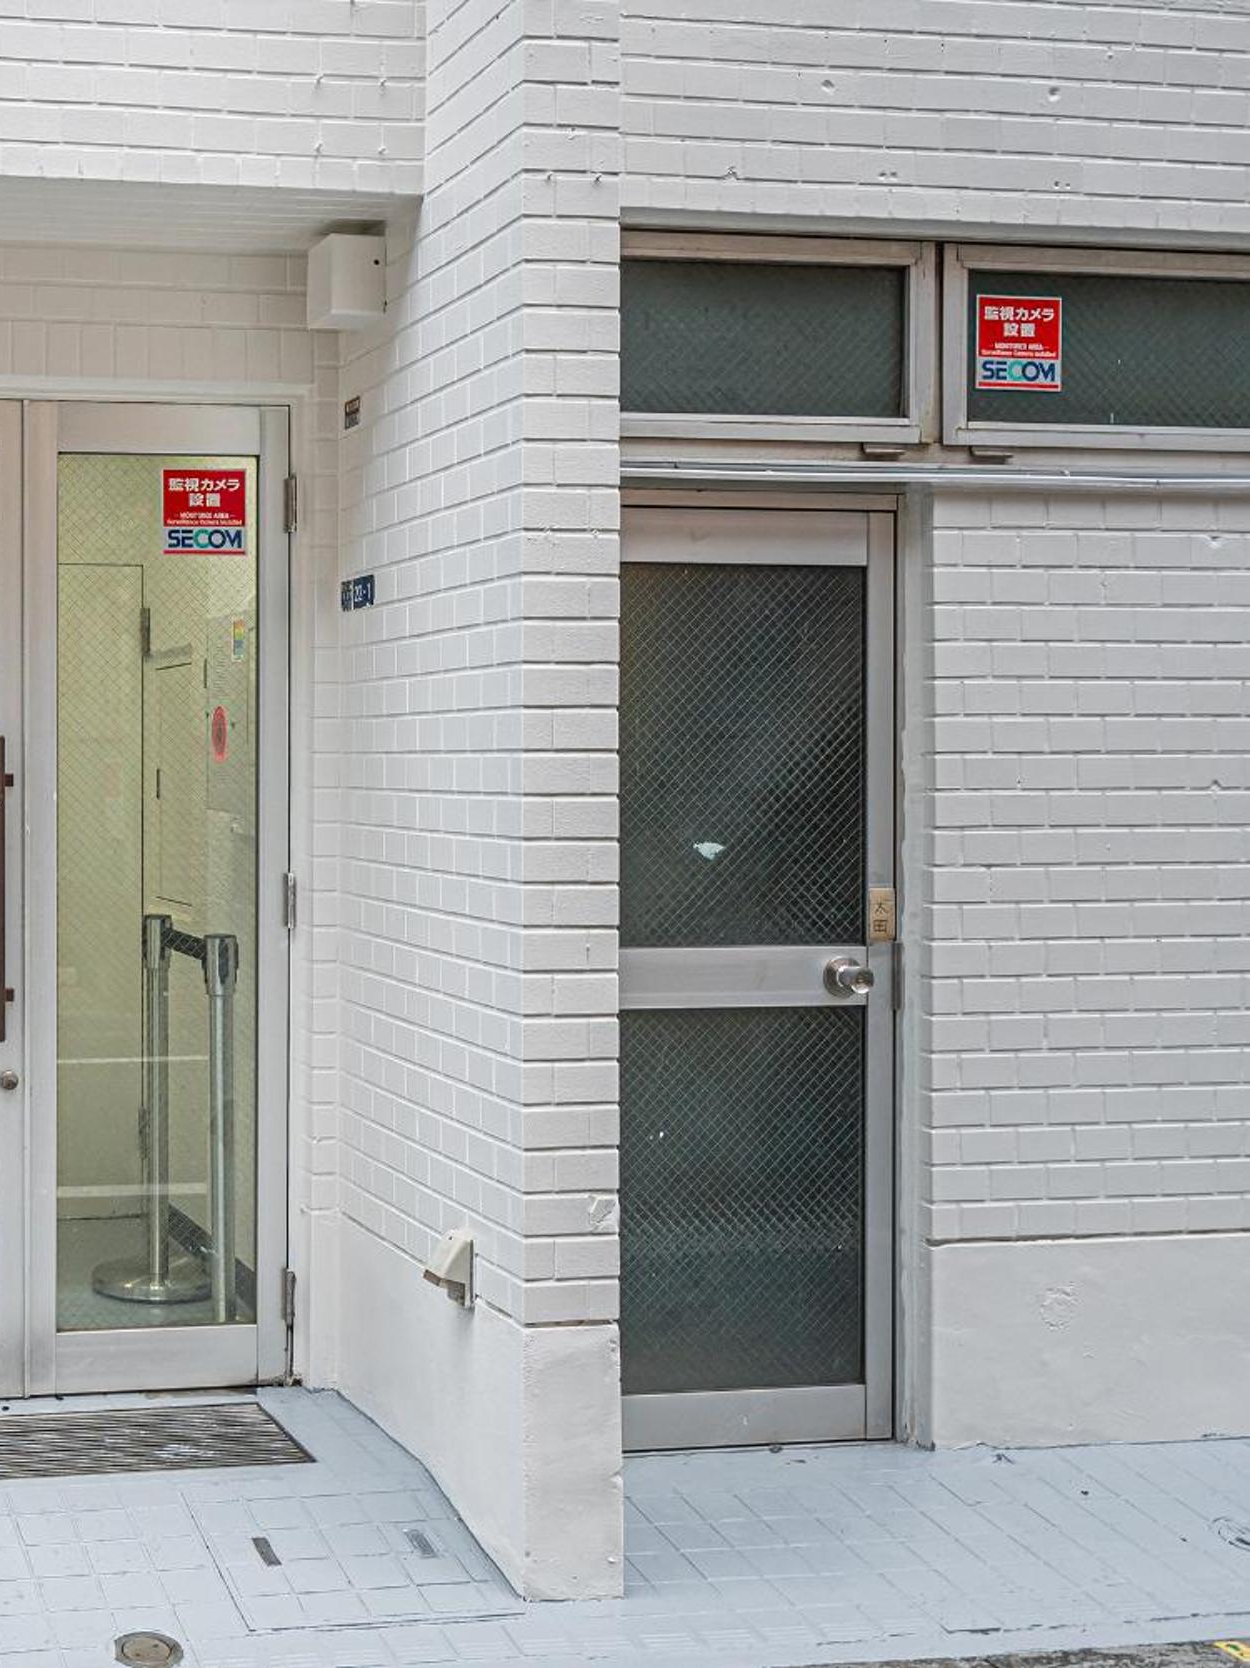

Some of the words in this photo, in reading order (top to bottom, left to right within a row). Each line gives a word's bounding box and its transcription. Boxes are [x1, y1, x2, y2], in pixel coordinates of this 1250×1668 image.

[984, 305, 1055, 322] 監視カメラ
[981, 360, 1056, 382] SECOM
[168, 477, 241, 492] 監視カメラ
[167, 528, 242, 549] SECOM
